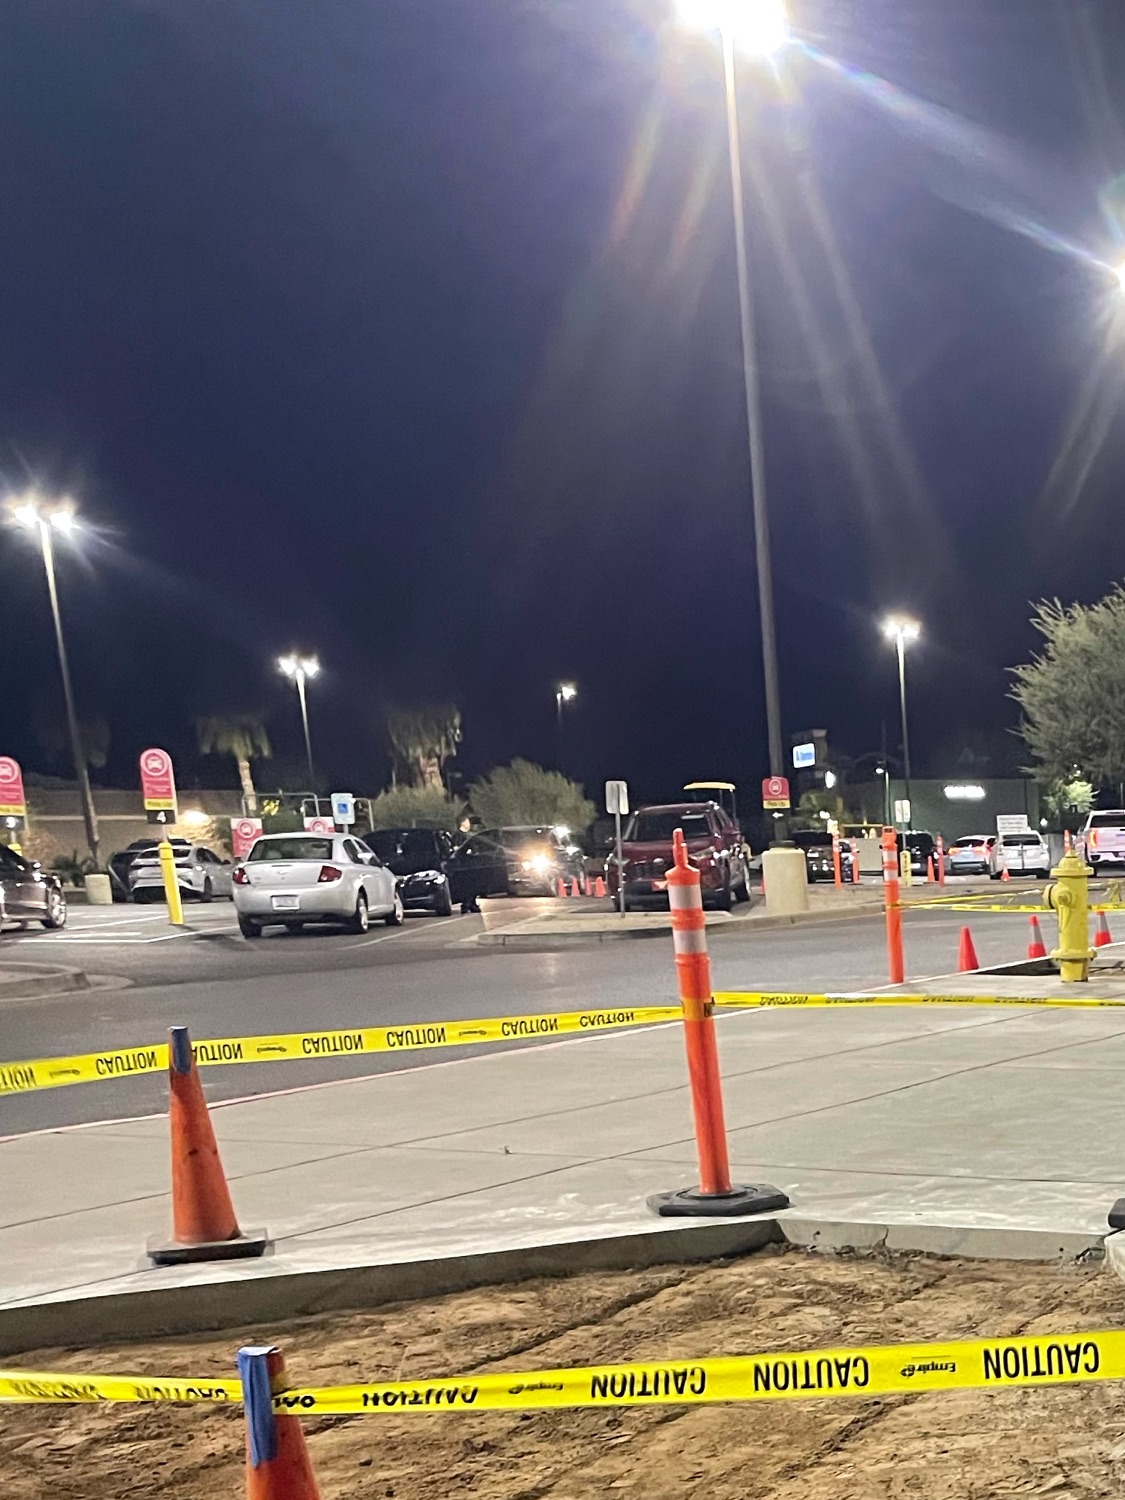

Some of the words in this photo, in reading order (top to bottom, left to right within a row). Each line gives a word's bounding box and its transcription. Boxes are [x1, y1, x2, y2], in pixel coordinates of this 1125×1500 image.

[156, 811, 167, 823] 4
[753, 1356, 870, 1392] CAUTION
[983, 1341, 1100, 1380] CAUTION
[590, 1366, 706, 1399] CAUTION
